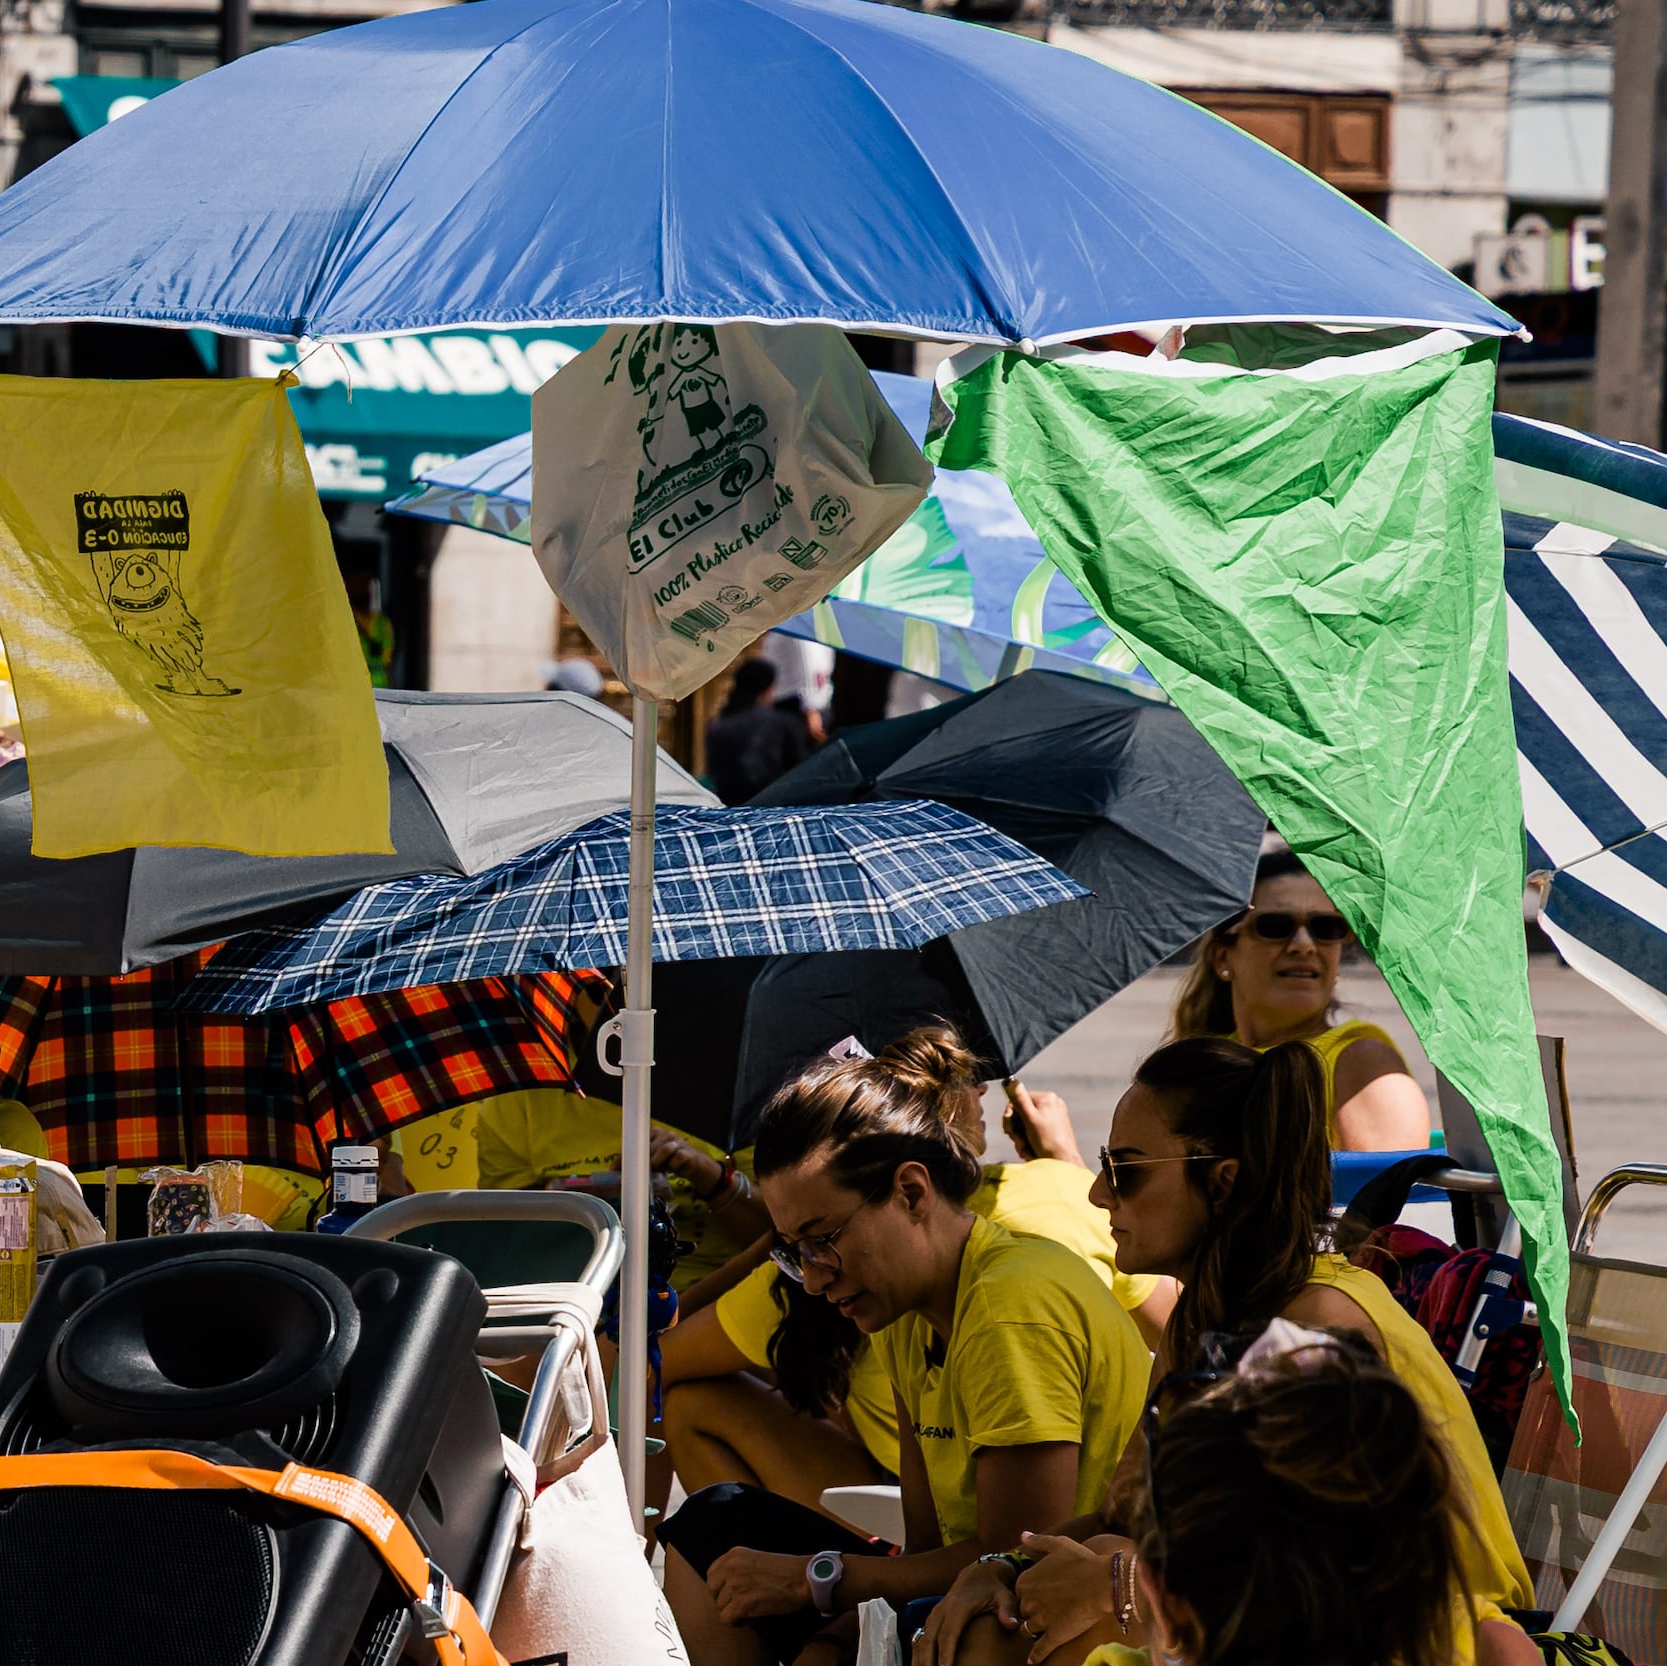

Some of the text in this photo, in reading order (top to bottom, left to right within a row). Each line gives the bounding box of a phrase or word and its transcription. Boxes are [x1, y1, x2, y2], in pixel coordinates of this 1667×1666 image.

[629, 499, 714, 564] El Club
[654, 571, 691, 607] 100%
